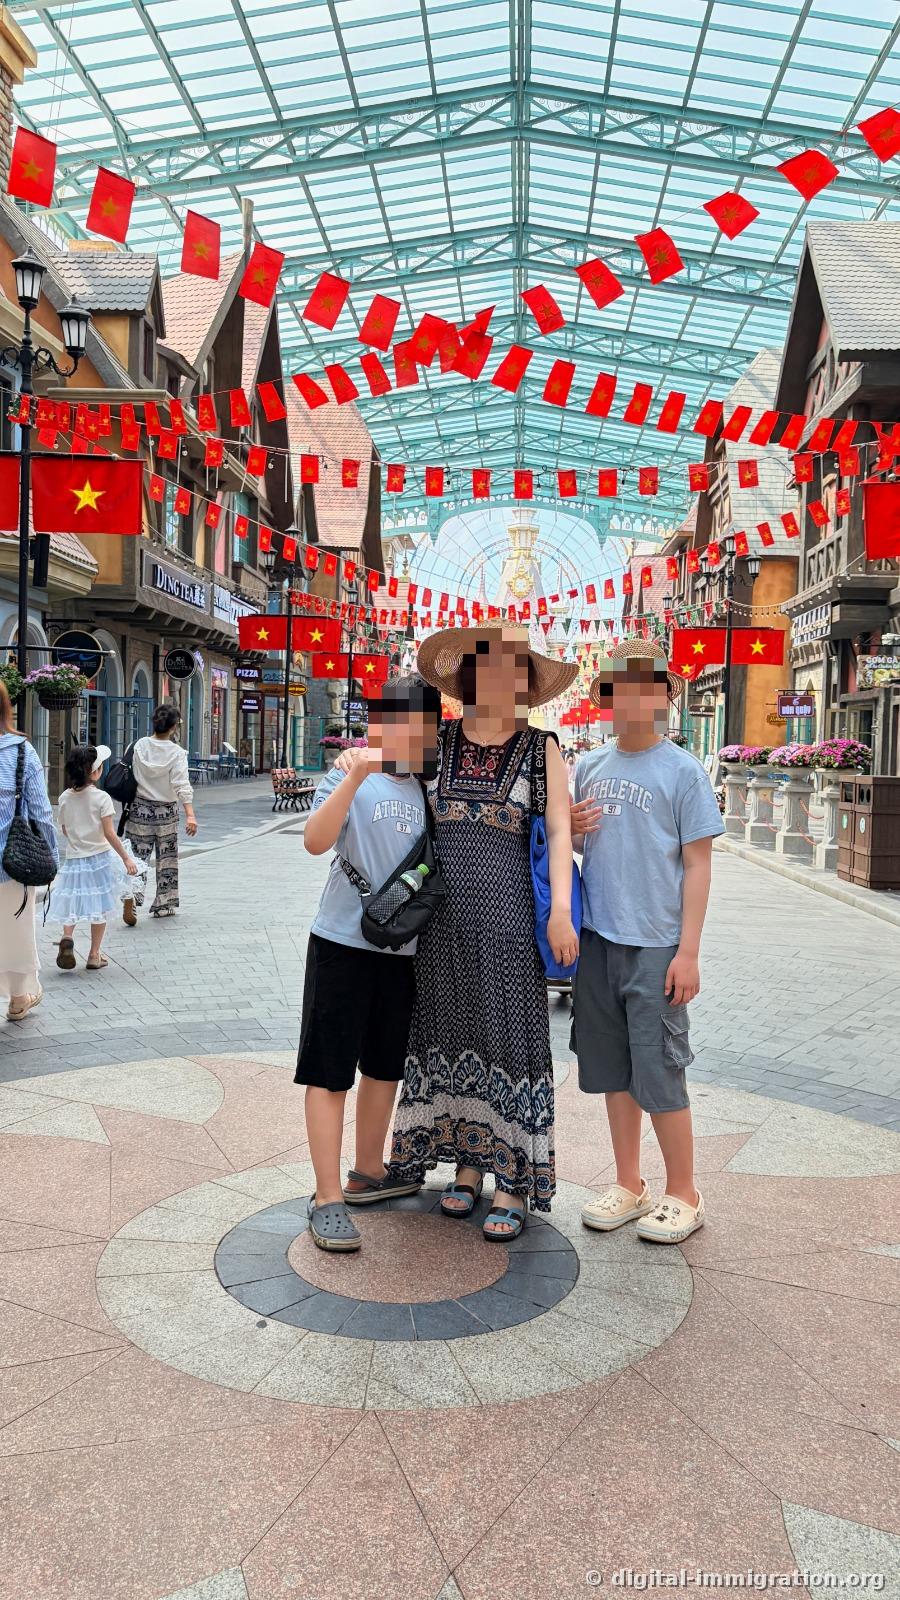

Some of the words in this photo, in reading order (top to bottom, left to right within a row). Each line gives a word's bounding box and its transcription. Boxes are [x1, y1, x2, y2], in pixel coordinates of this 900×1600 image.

[156, 564, 180, 596] DING
[236, 669, 259, 677] PIZZA
[534, 734, 546, 768] exper
[535, 773, 547, 813] expert
[588, 778, 654, 814] THLETIC
[372, 800, 427, 828] ATHLETI
